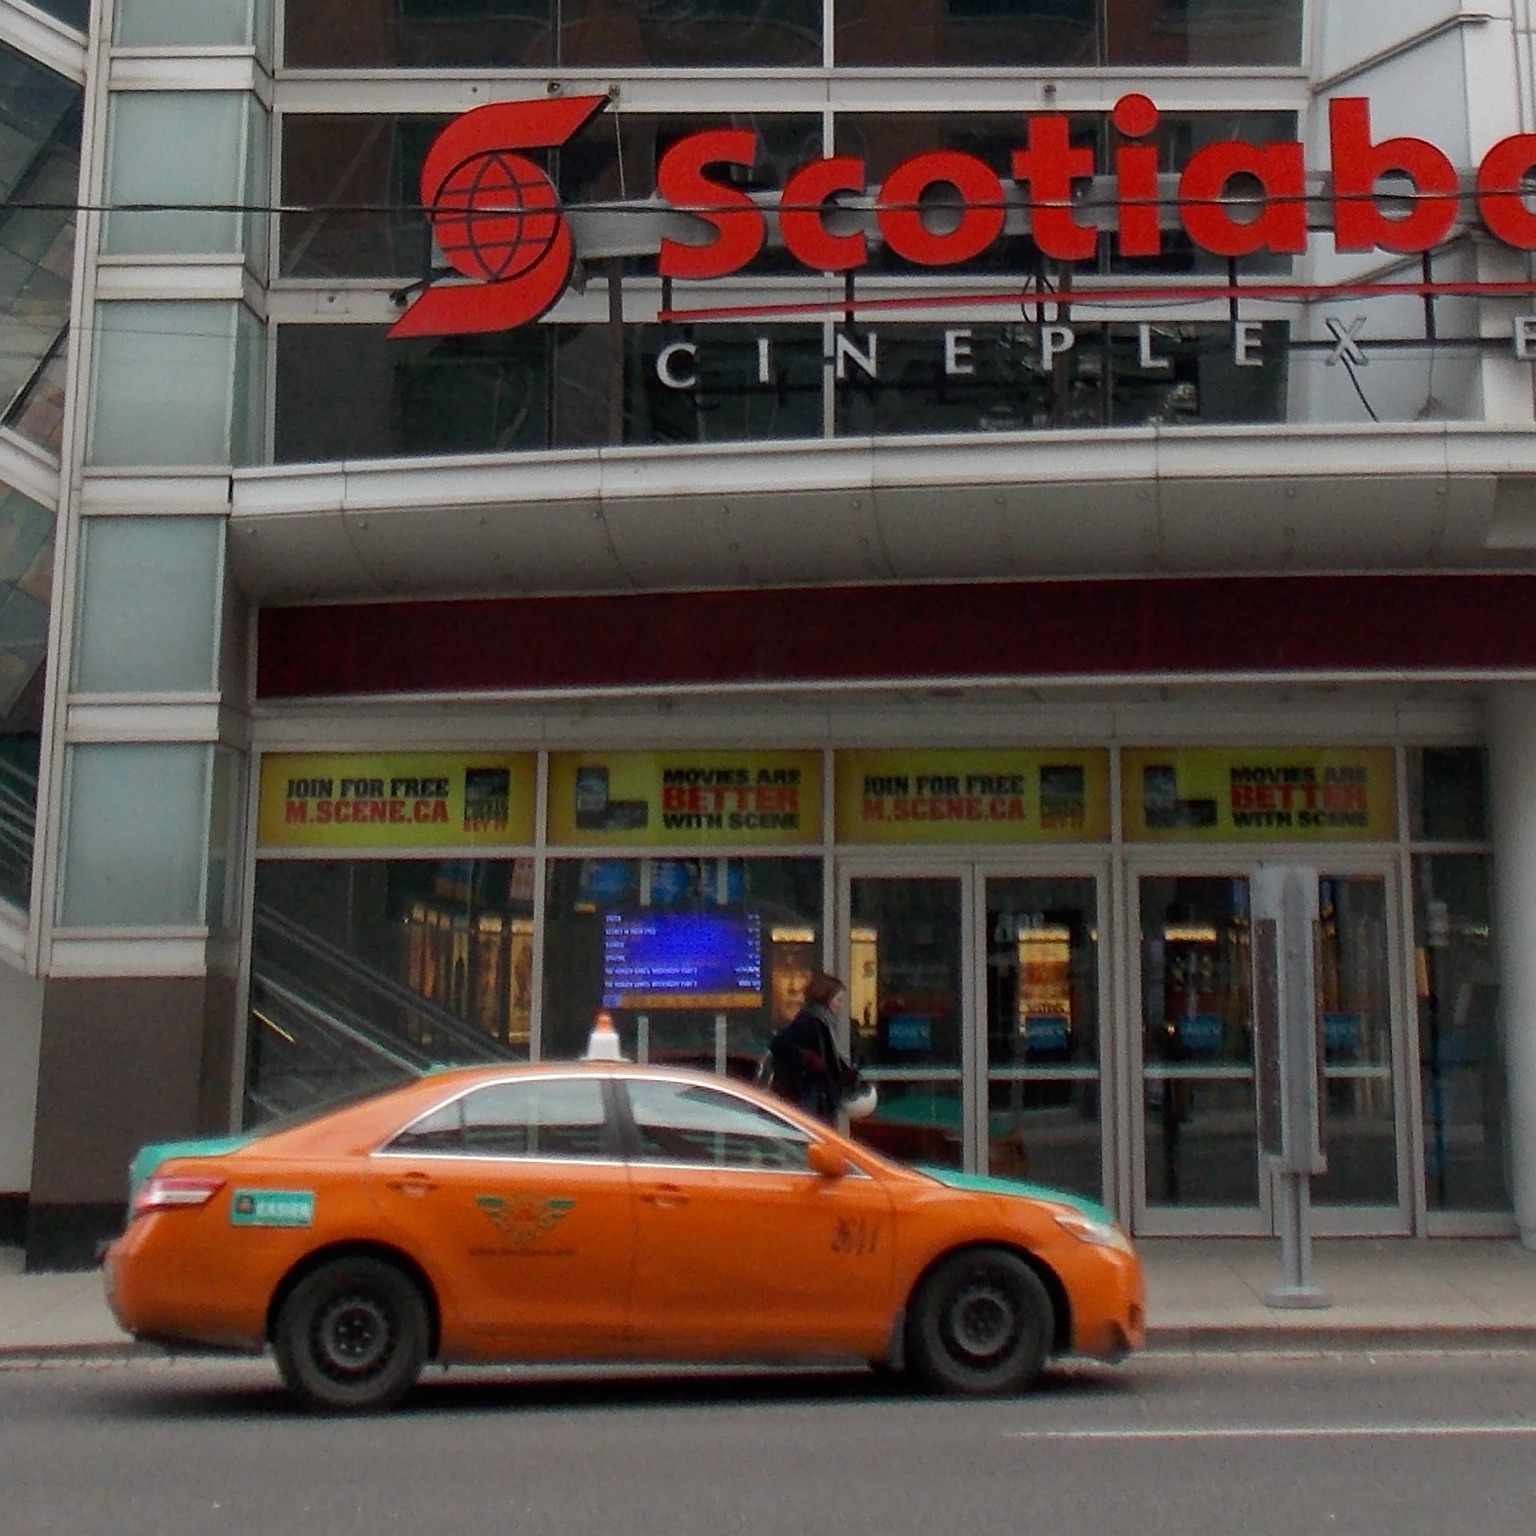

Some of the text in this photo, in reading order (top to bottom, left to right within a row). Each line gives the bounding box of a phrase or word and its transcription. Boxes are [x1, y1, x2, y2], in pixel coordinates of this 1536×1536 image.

[656, 316, 1369, 389] CINEPLEX
[663, 769, 800, 785] MOVIES ARE
[1230, 767, 1317, 784] MOVIES
[288, 778, 449, 798] JOIN FOR FREE
[864, 776, 1025, 796] JOIN FOR FREE
[662, 786, 799, 813] BETTER
[1231, 784, 1368, 811] BETTER
[285, 800, 449, 824] M.SCENE.CA
[862, 798, 1025, 822] M.SCENE.CA
[1232, 811, 1293, 828] WITH
[663, 813, 800, 830] WITH SCENE
